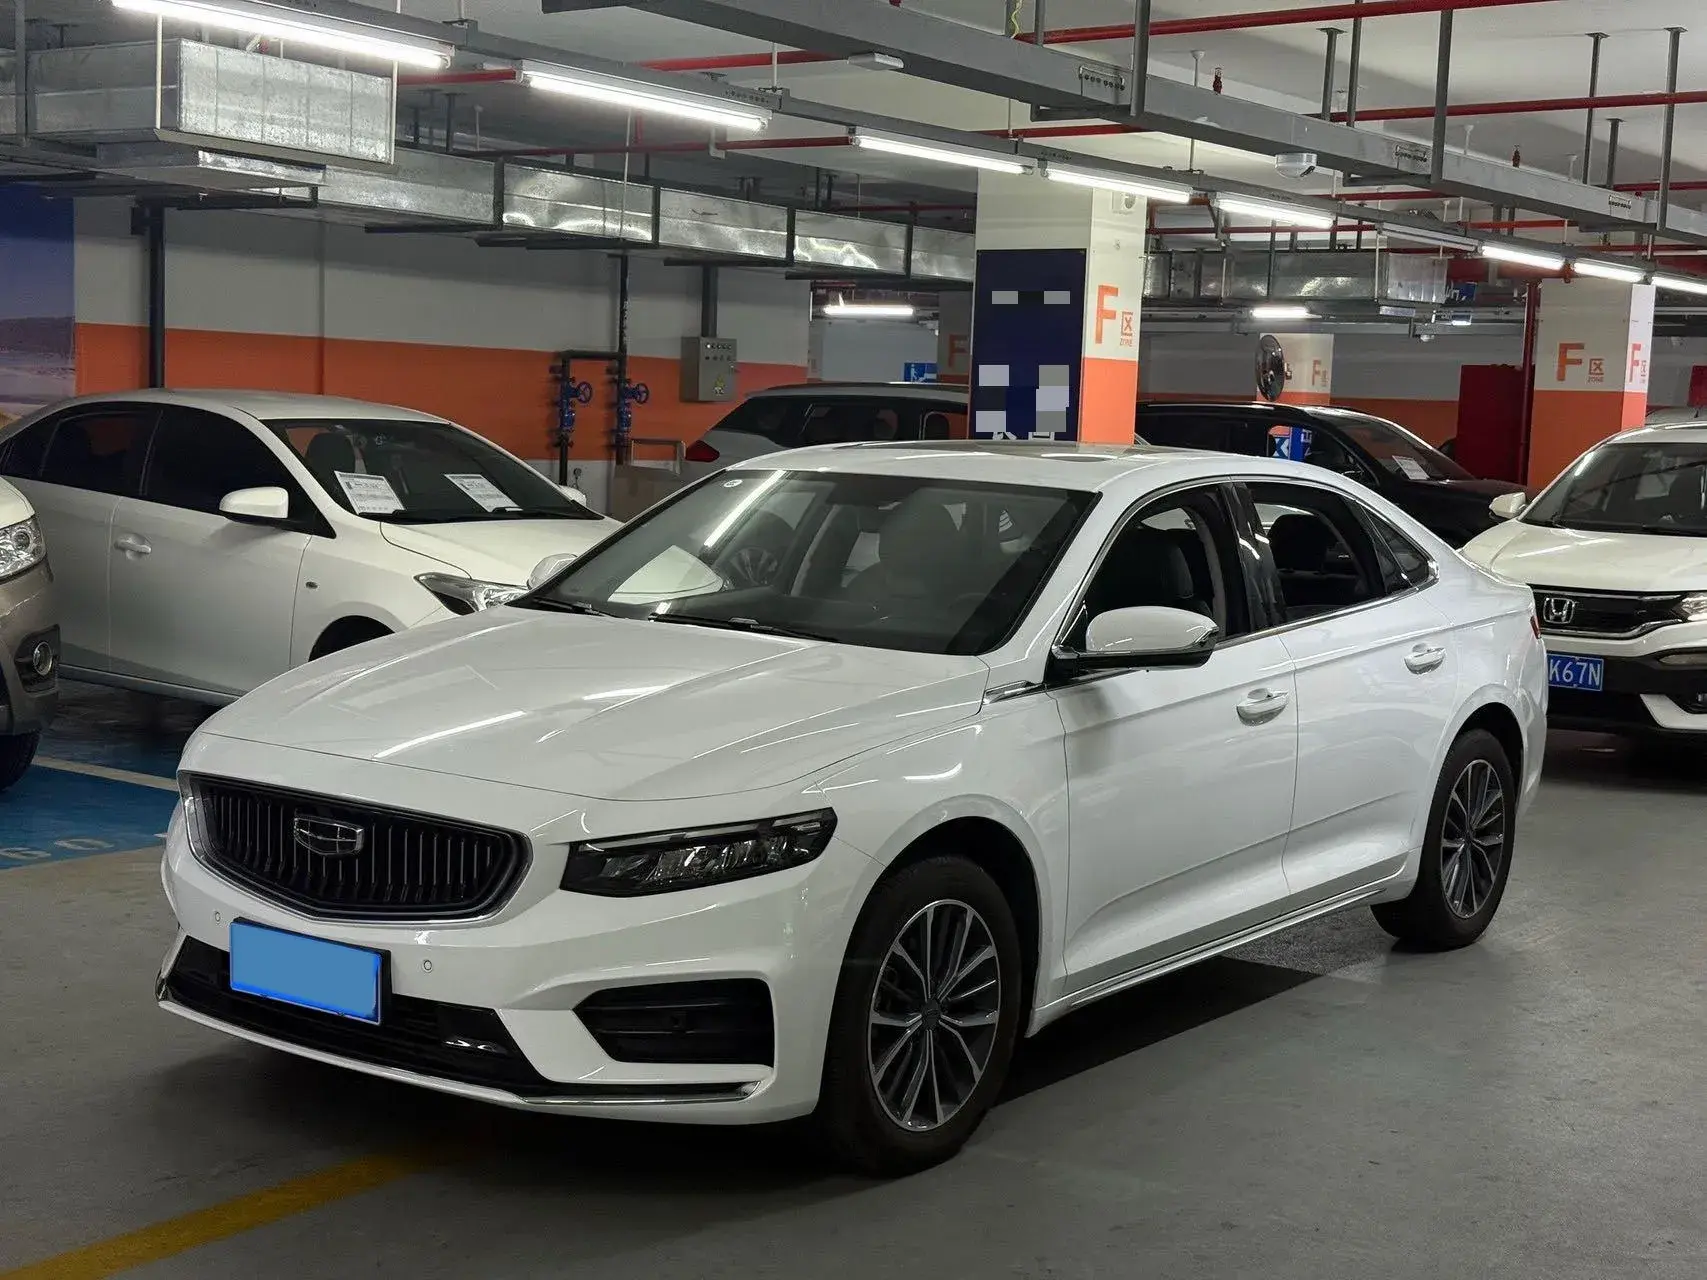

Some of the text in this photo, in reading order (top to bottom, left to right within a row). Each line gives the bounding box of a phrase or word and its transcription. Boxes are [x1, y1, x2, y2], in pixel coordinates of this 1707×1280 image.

[1095, 284, 1119, 344] F
[949, 334, 969, 368] F
[1557, 342, 1584, 381] F
[1629, 343, 1641, 382] F
[1312, 359, 1321, 386] F
[1549, 659, 1601, 686] K67N
